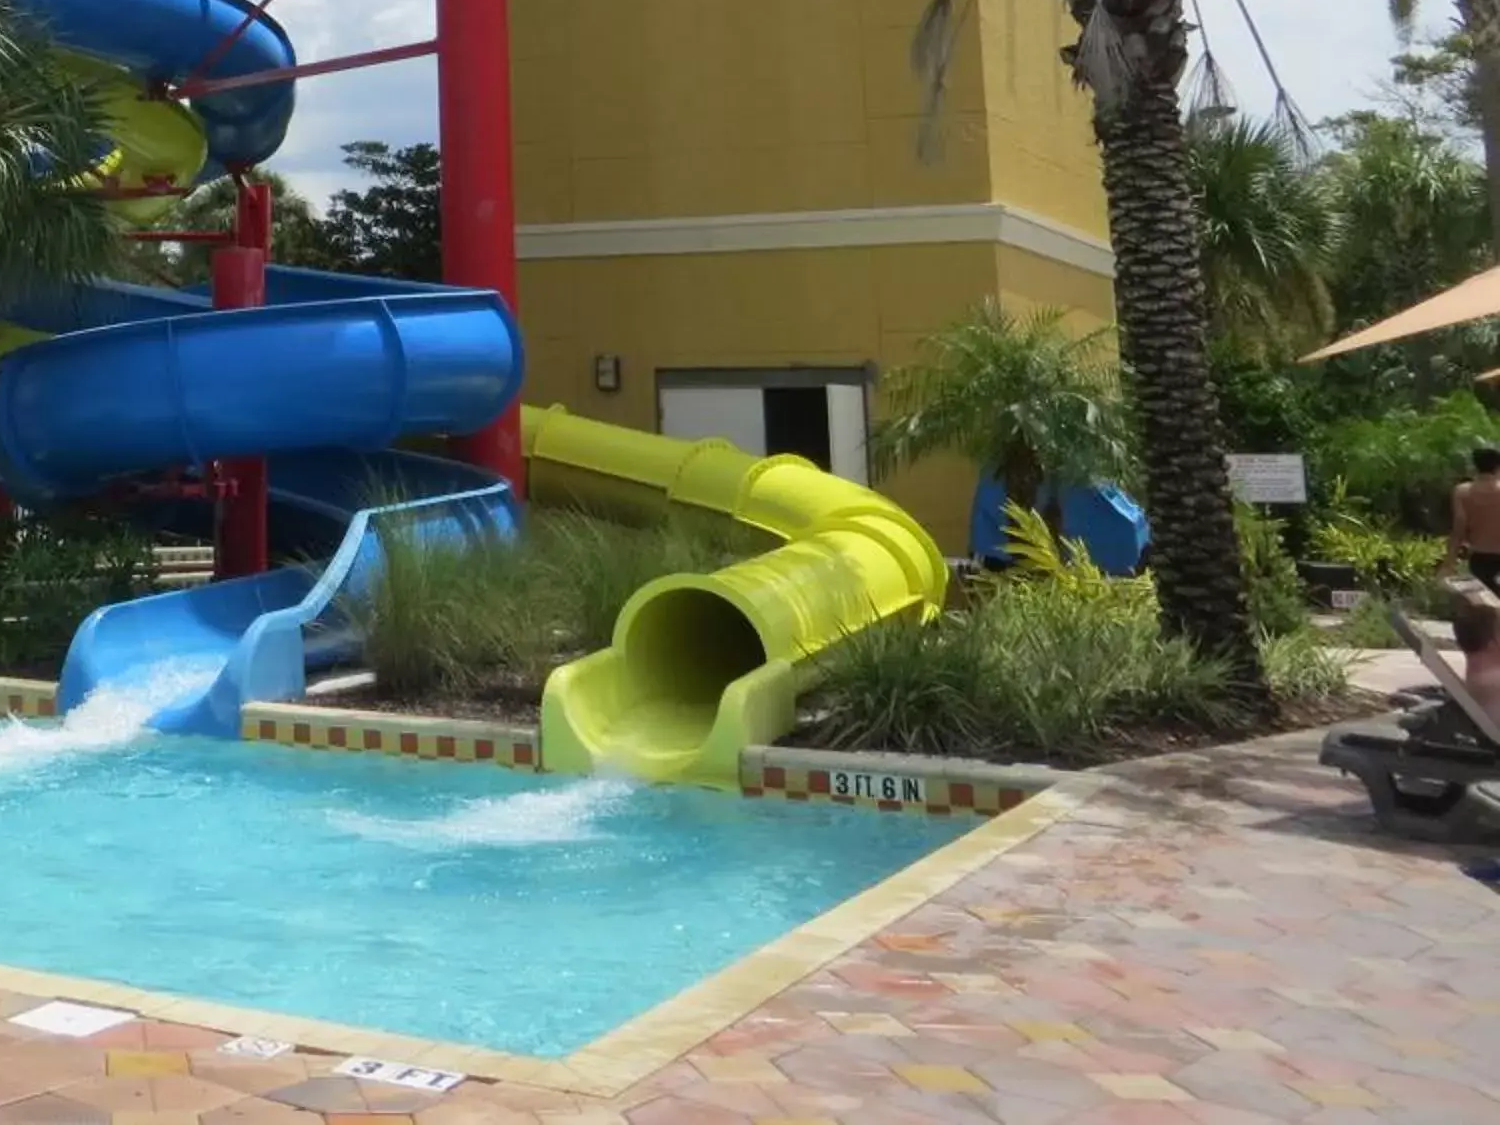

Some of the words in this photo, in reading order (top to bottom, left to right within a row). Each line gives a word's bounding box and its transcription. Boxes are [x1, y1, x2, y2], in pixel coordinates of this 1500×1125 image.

[836, 773, 849, 795] 3
[882, 777, 896, 799] 6
[351, 1061, 384, 1074] 3
[395, 1068, 456, 1087] FT
